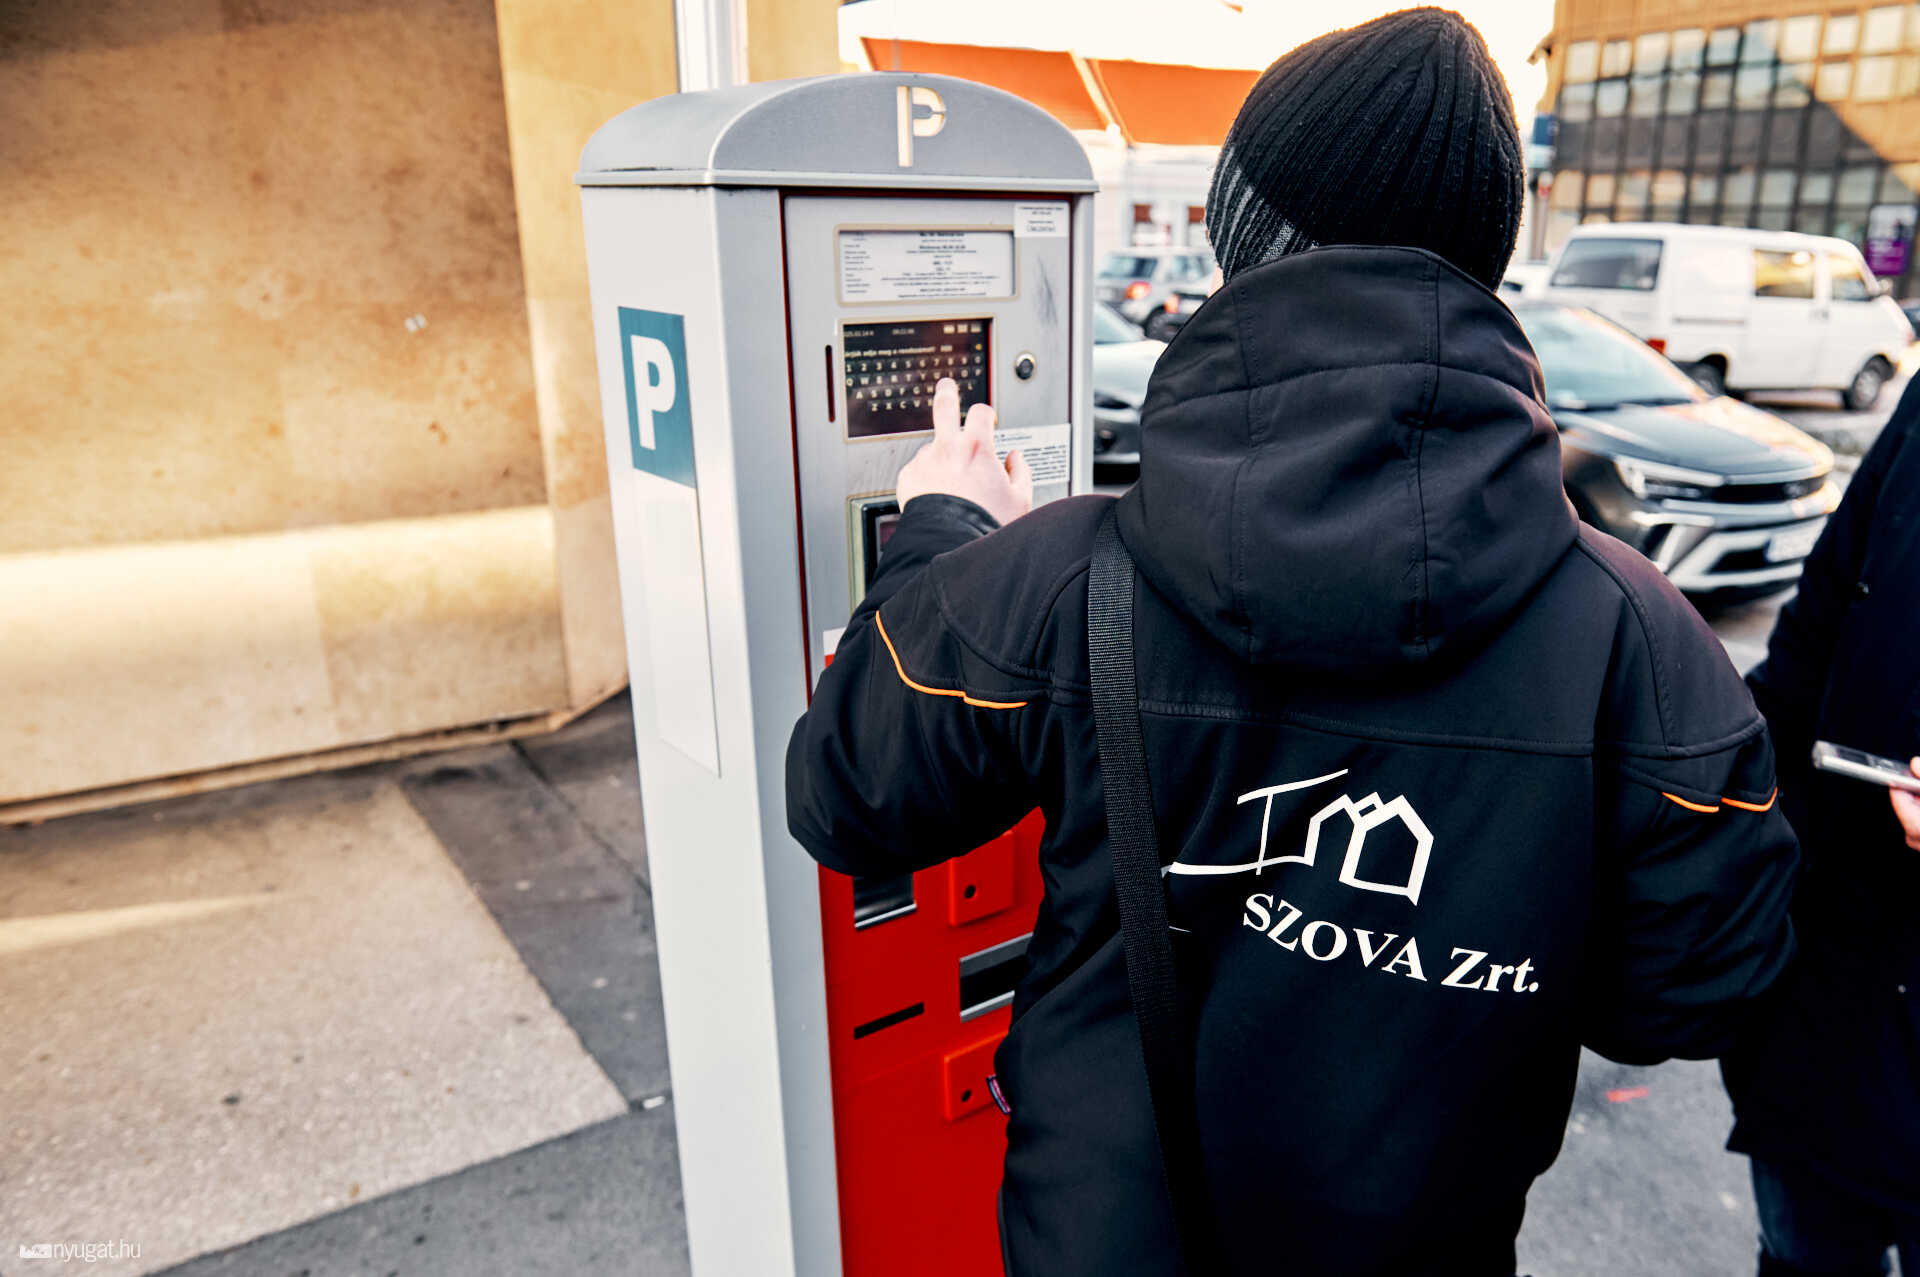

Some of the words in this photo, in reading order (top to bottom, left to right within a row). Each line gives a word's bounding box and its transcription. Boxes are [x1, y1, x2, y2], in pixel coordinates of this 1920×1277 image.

[895, 85, 947, 168] P
[630, 334, 676, 451] P
[1242, 892, 1428, 982] SZOVA
[1440, 946, 1540, 993] Zrt.
